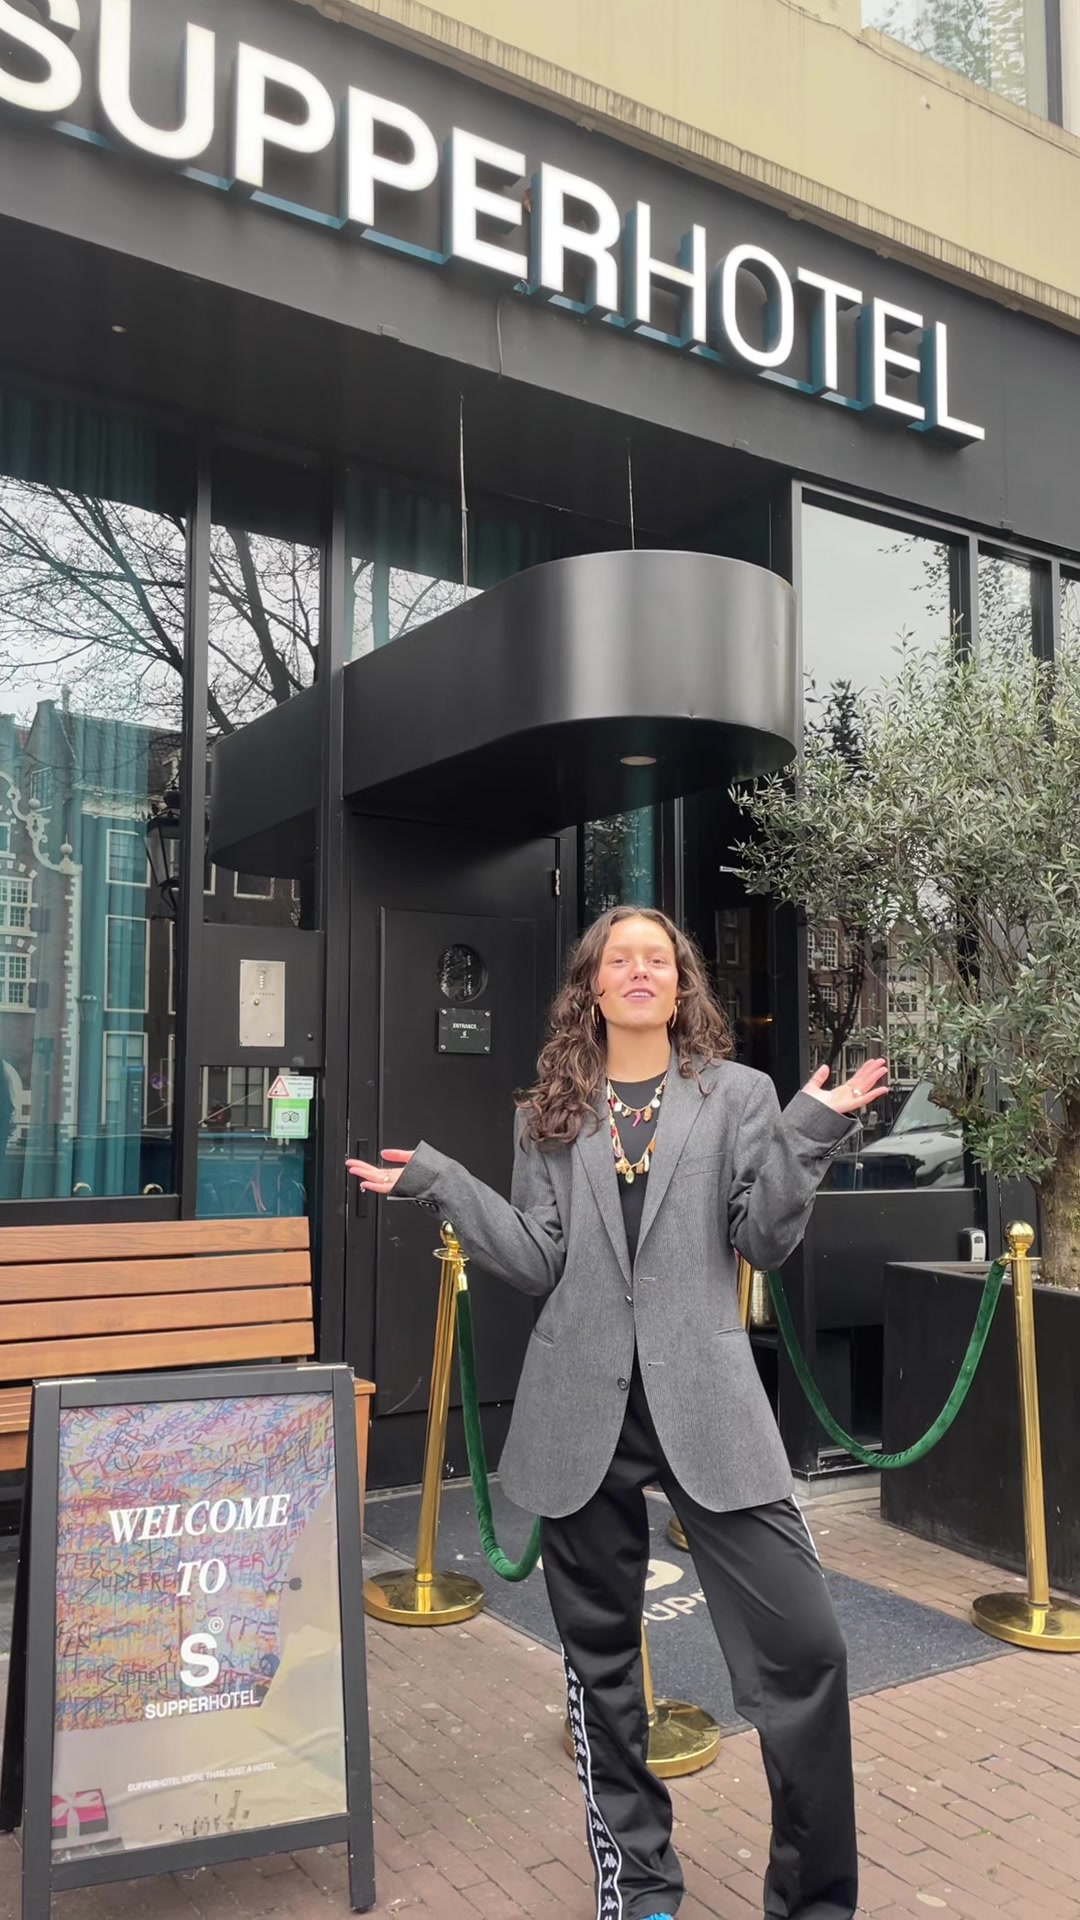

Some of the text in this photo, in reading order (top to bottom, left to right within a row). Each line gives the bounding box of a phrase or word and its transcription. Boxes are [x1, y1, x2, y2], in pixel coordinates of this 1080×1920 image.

[108, 1494, 290, 1543] WELCOME
[177, 1558, 226, 1597] TO
[180, 1633, 219, 1688] S
[144, 1689, 260, 1719] SUPPERHOTEL
[127, 1776, 181, 1792] SUPPERHOTEL
[182, 1772, 204, 1784] MORE
[205, 1769, 226, 1780] THAN
[226, 1765, 246, 1777] JUST
[253, 1761, 277, 1772] HOTEL
